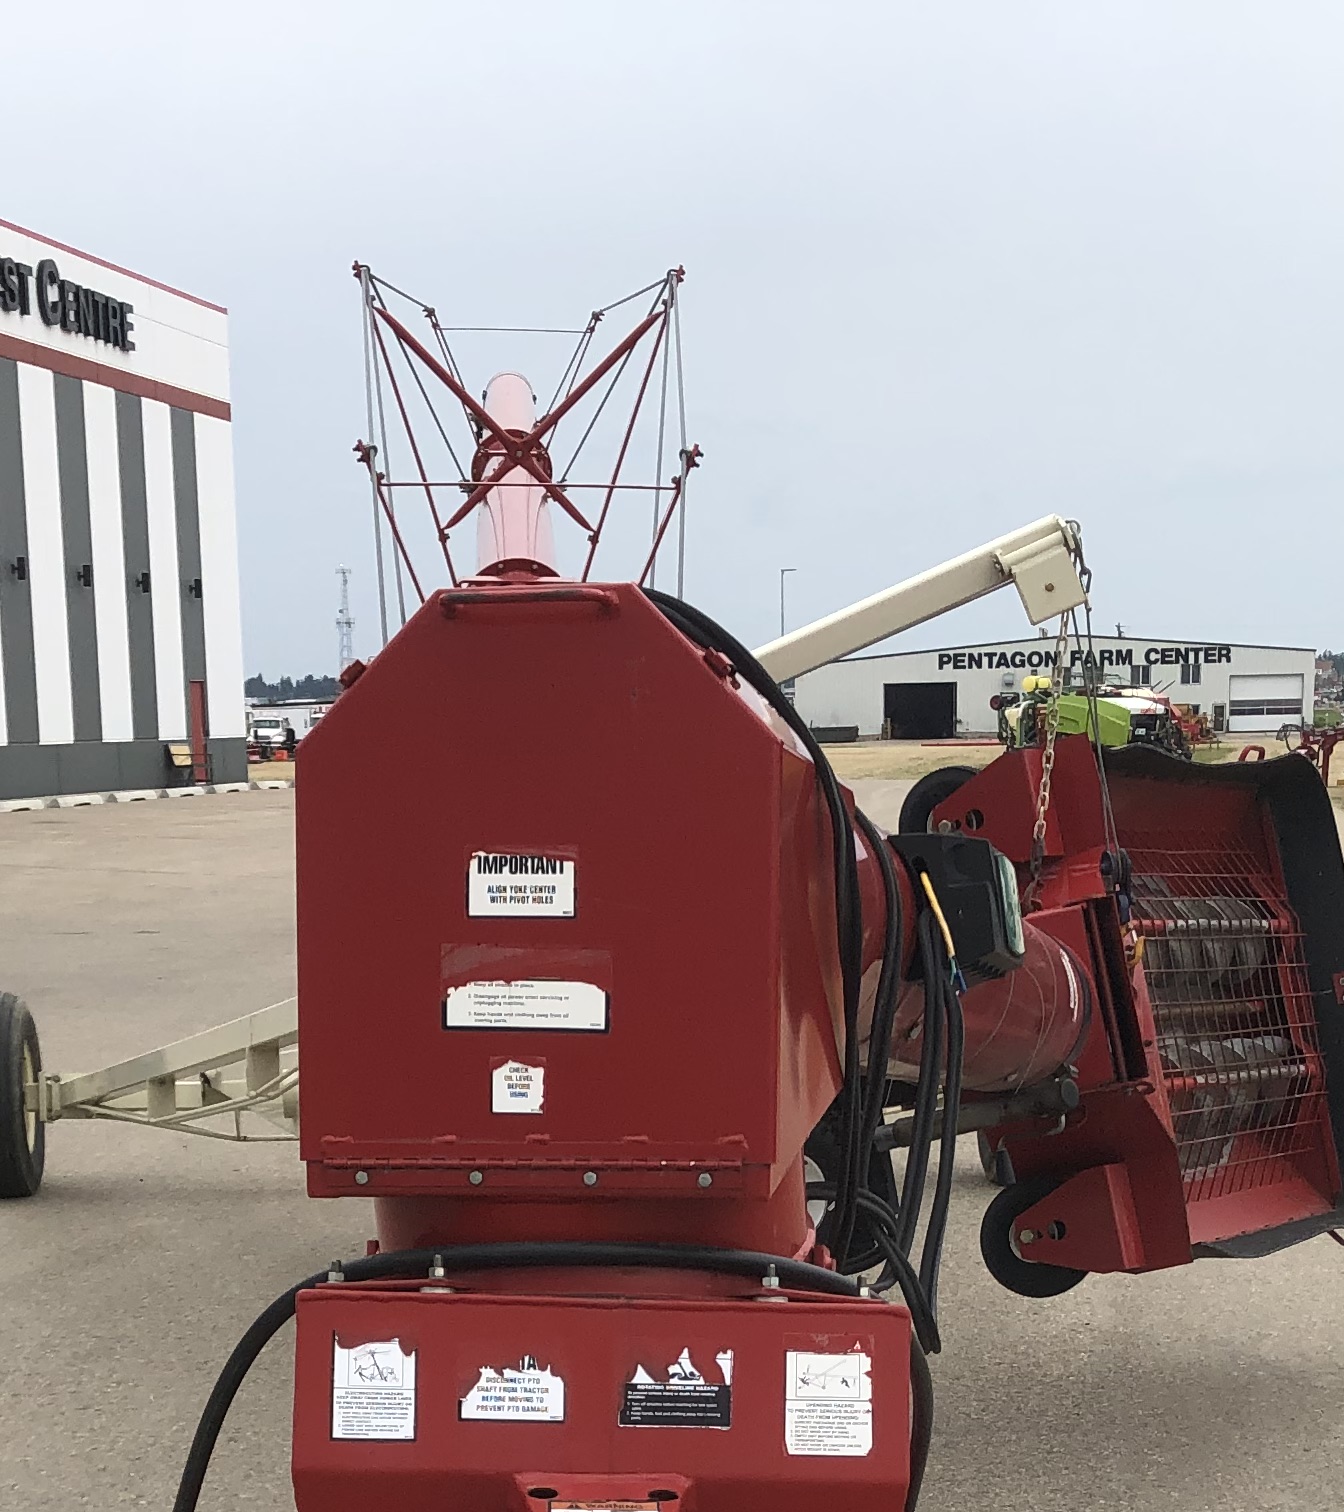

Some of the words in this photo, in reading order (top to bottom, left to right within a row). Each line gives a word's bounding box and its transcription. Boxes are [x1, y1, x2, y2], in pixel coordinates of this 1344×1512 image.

[36, 258, 136, 352] CENTRE
[937, 650, 1057, 670] PENTAGON
[1070, 648, 1133, 667] FARM
[1144, 646, 1232, 665] CENTER
[476, 855, 564, 875] IMPORTANT
[486, 885, 507, 894] ALIGN
[509, 885, 528, 894] YOKE
[529, 885, 557, 895] CENTER
[489, 895, 507, 904] WITH
[509, 895, 530, 904] PIVOT
[531, 895, 554, 905] HOLES
